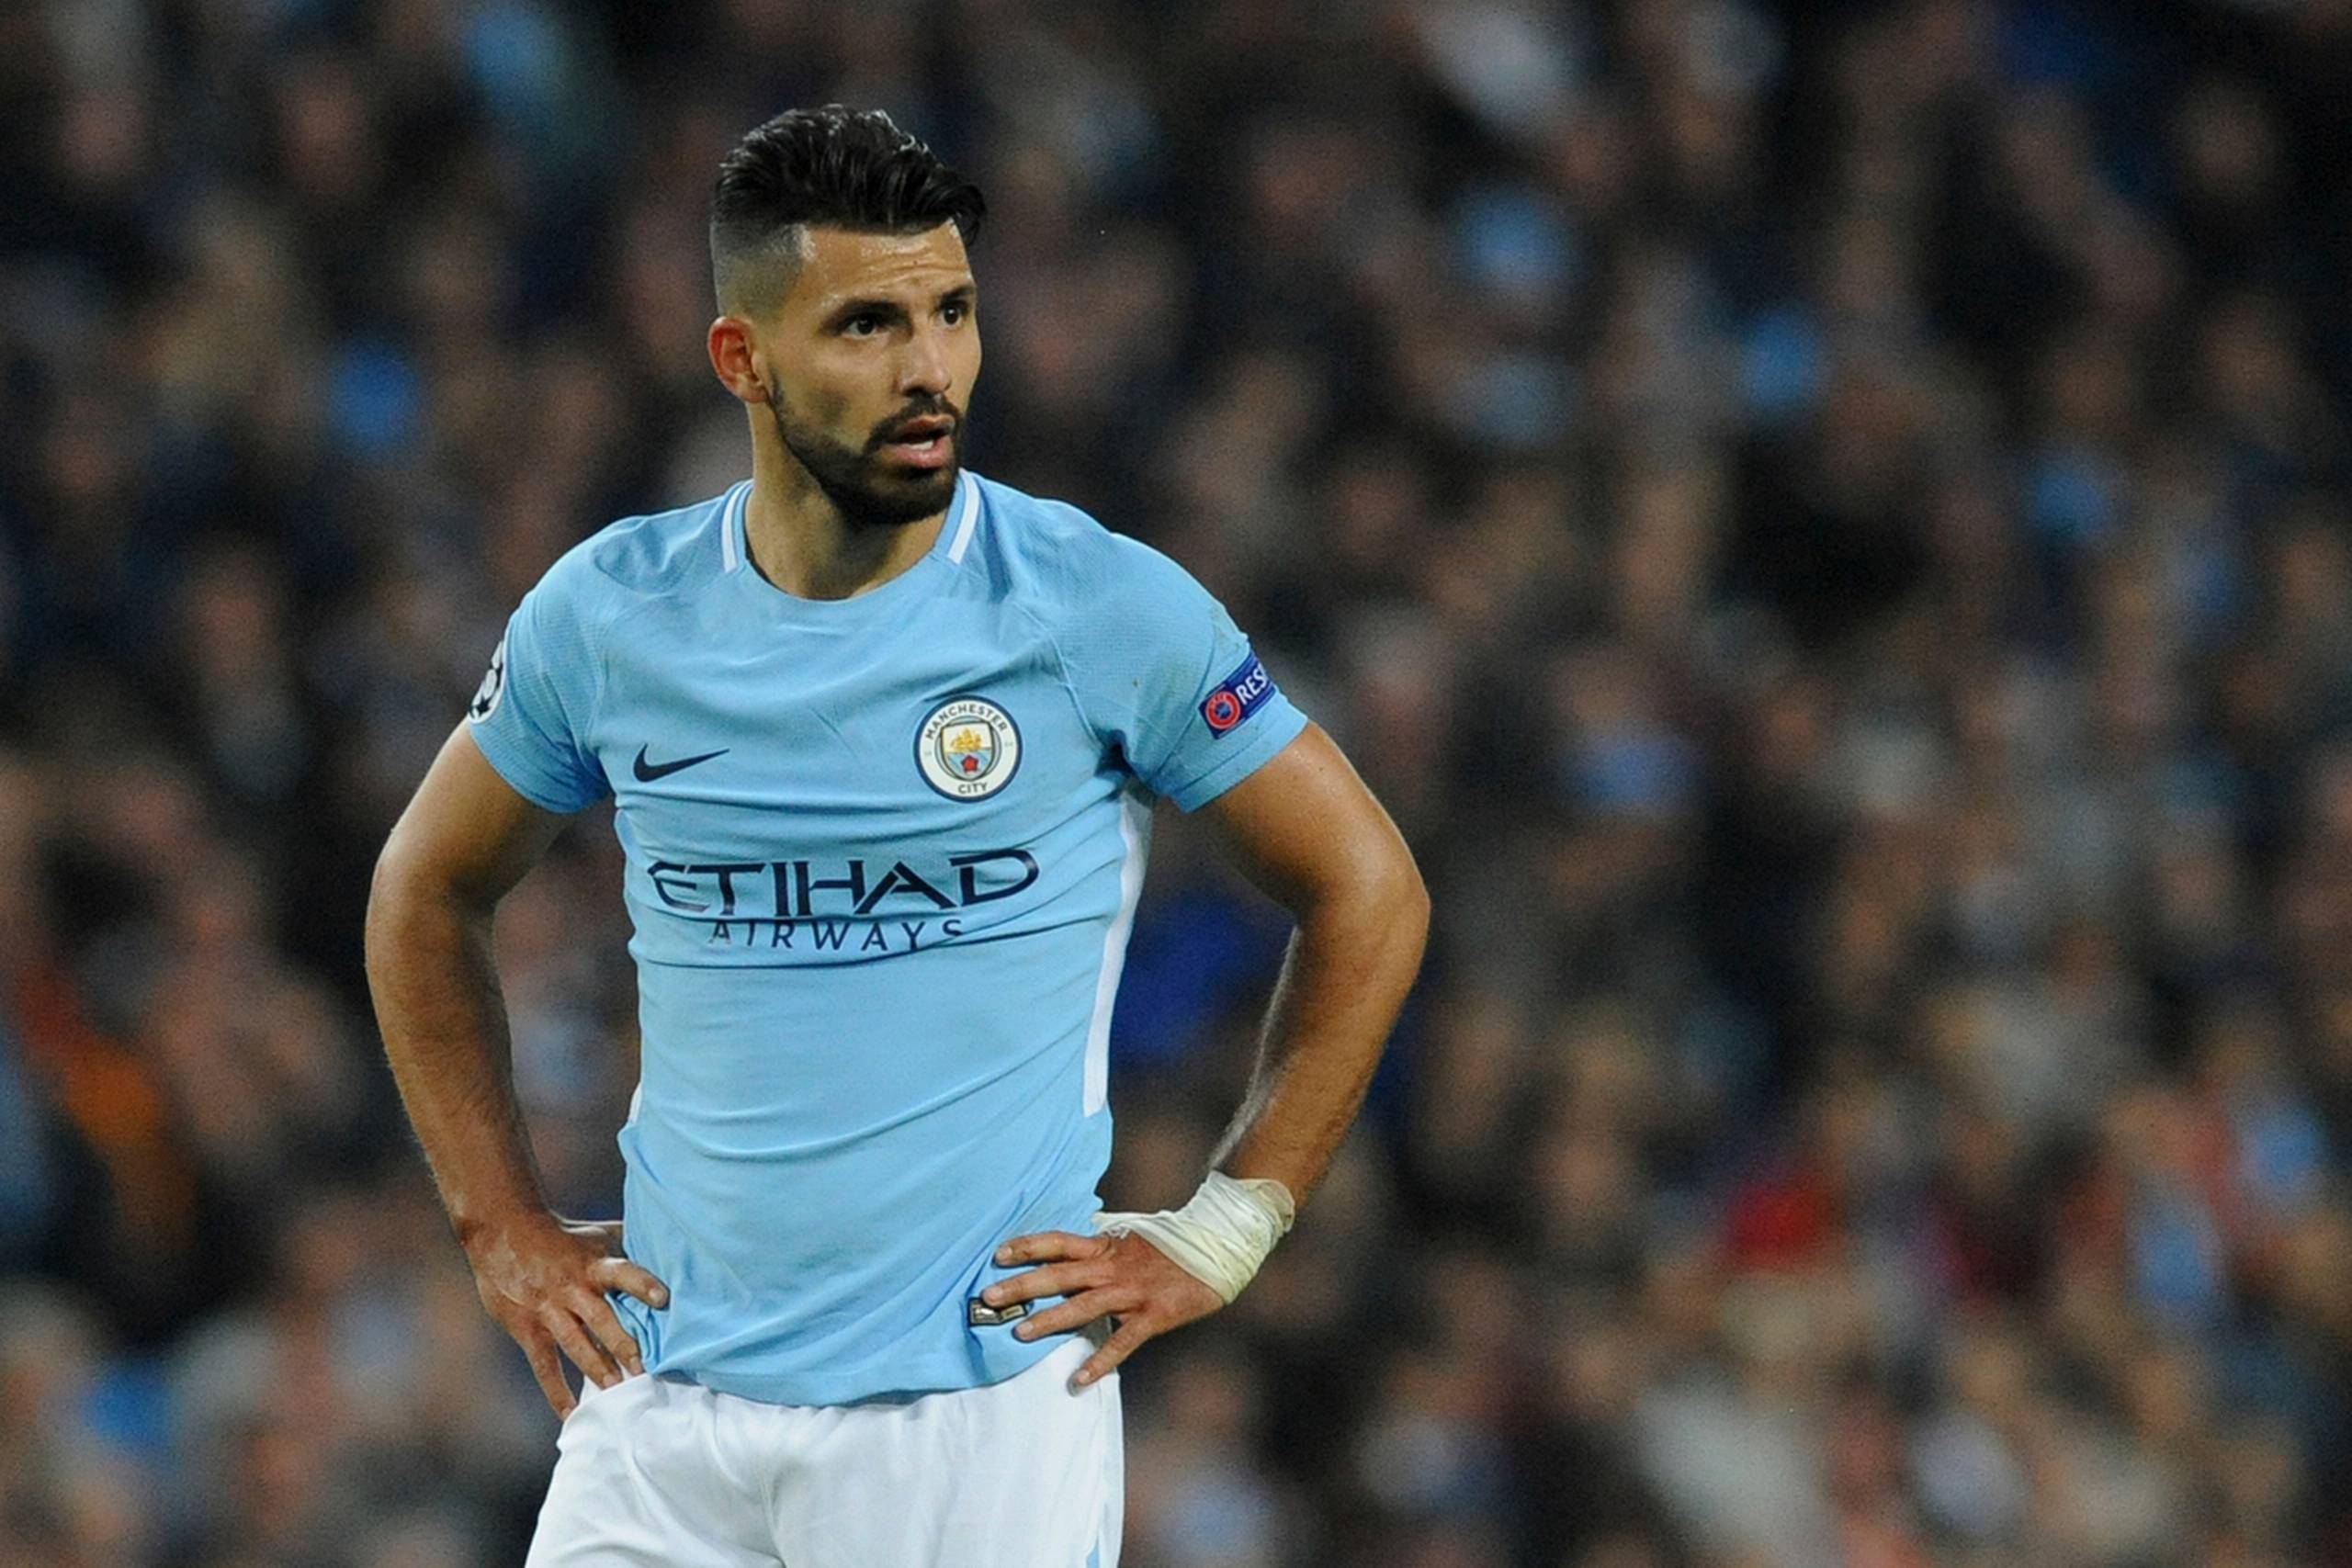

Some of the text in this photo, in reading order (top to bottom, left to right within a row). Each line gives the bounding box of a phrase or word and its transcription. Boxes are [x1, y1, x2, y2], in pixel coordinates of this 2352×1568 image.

[925, 703, 1008, 739] MANCHESTER
[957, 782, 988, 794] CITY
[647, 849, 1040, 917] ETIHAD
[708, 919, 964, 952] AIRWAYS
